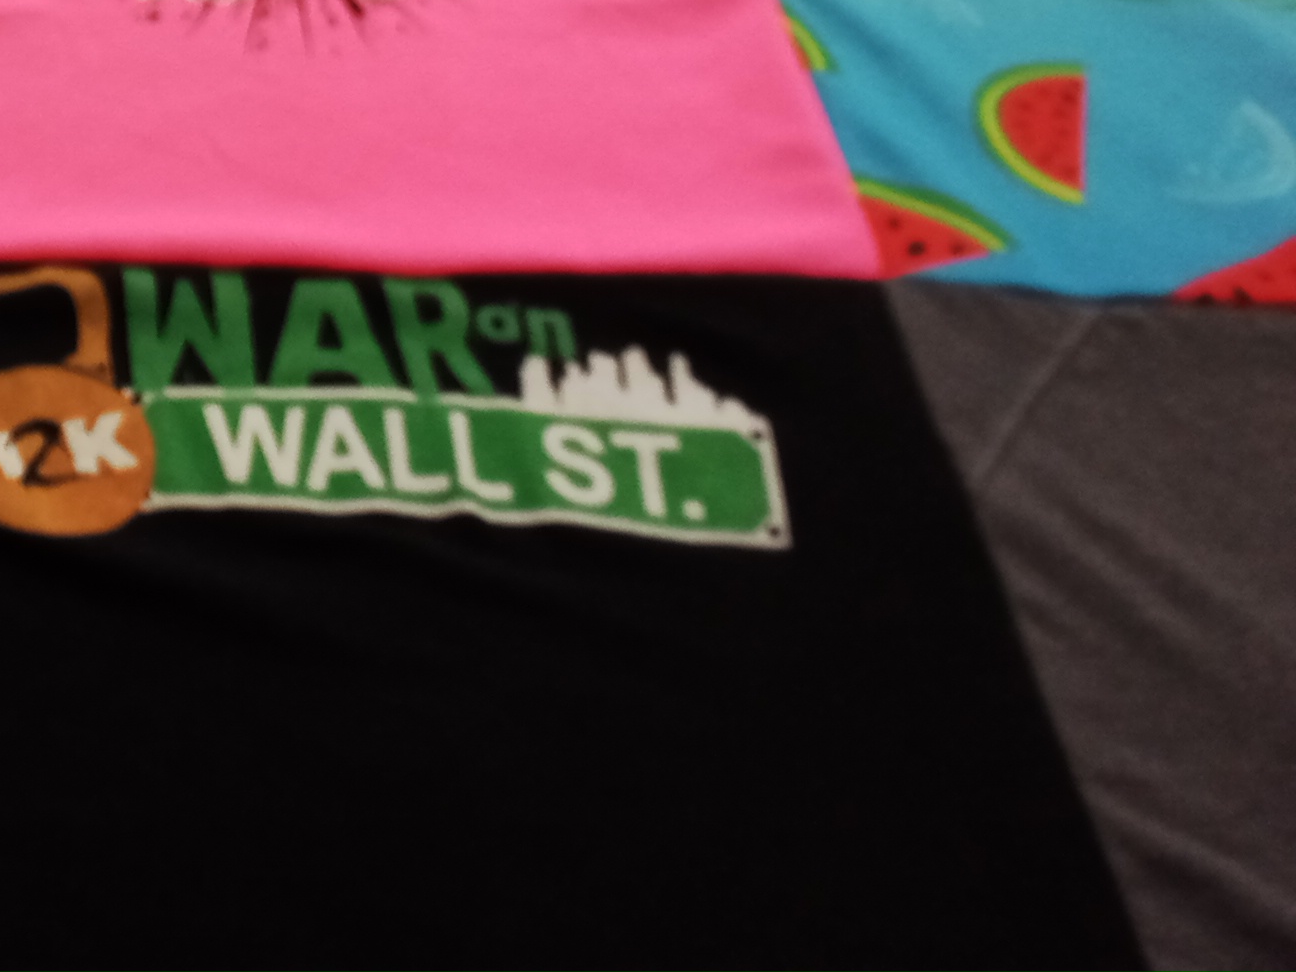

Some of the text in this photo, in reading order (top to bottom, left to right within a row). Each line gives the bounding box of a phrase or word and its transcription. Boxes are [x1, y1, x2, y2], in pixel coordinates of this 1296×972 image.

[122, 266, 577, 402] WAR on
[204, 403, 704, 522] WALL ST.
